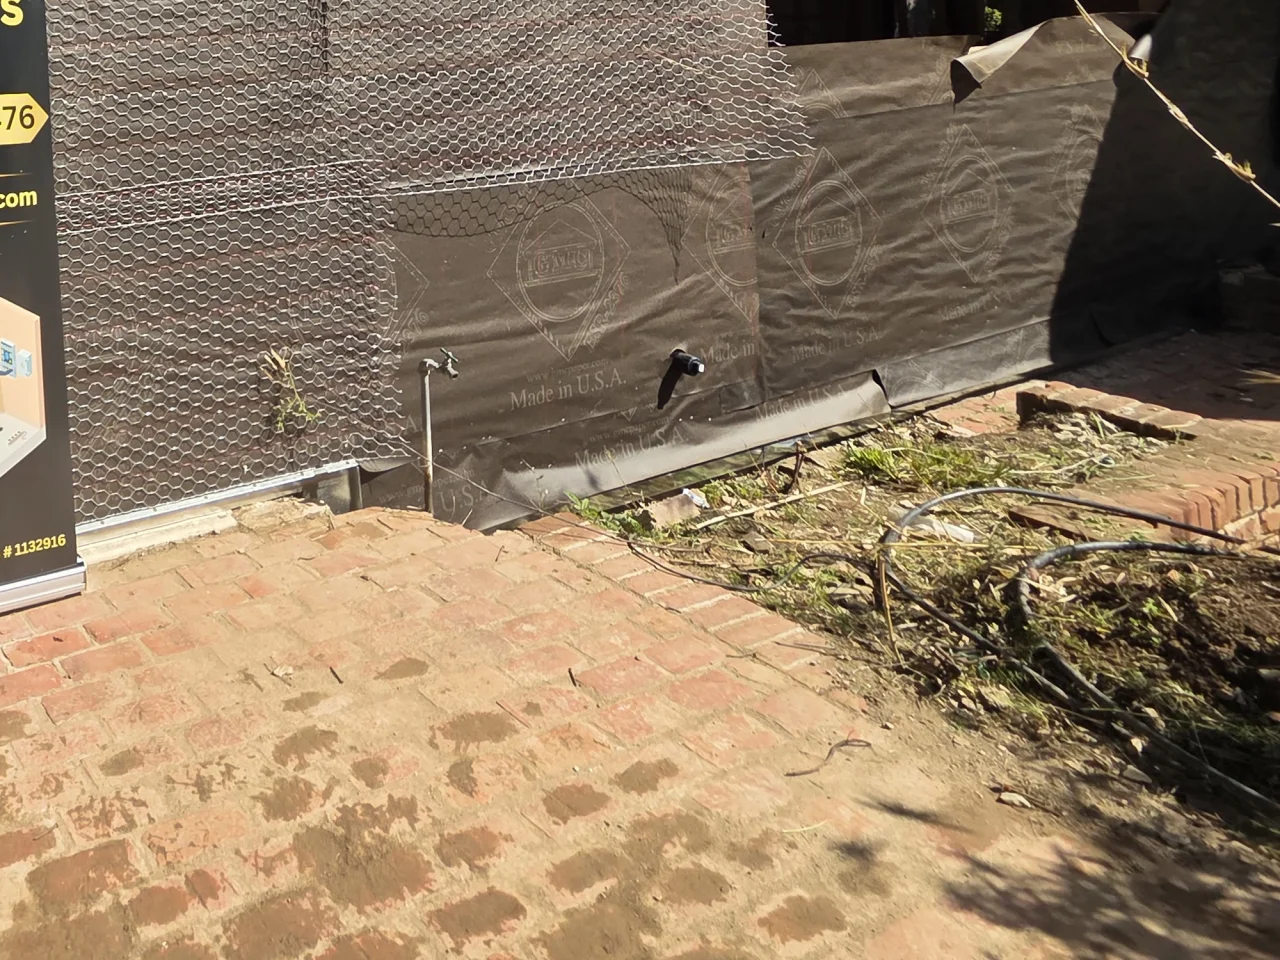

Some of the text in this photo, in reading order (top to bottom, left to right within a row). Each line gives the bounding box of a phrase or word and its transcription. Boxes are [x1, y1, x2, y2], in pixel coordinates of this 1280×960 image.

[700, 340, 756, 364] Made in
[509, 368, 627, 410] Made in U.S.A.
[754, 397, 789, 420] Made
[574, 445, 617, 468] Made
[619, 440, 635, 459] in
[3, 545, 13, 559] #
[14, 534, 66, 557] 1132916
